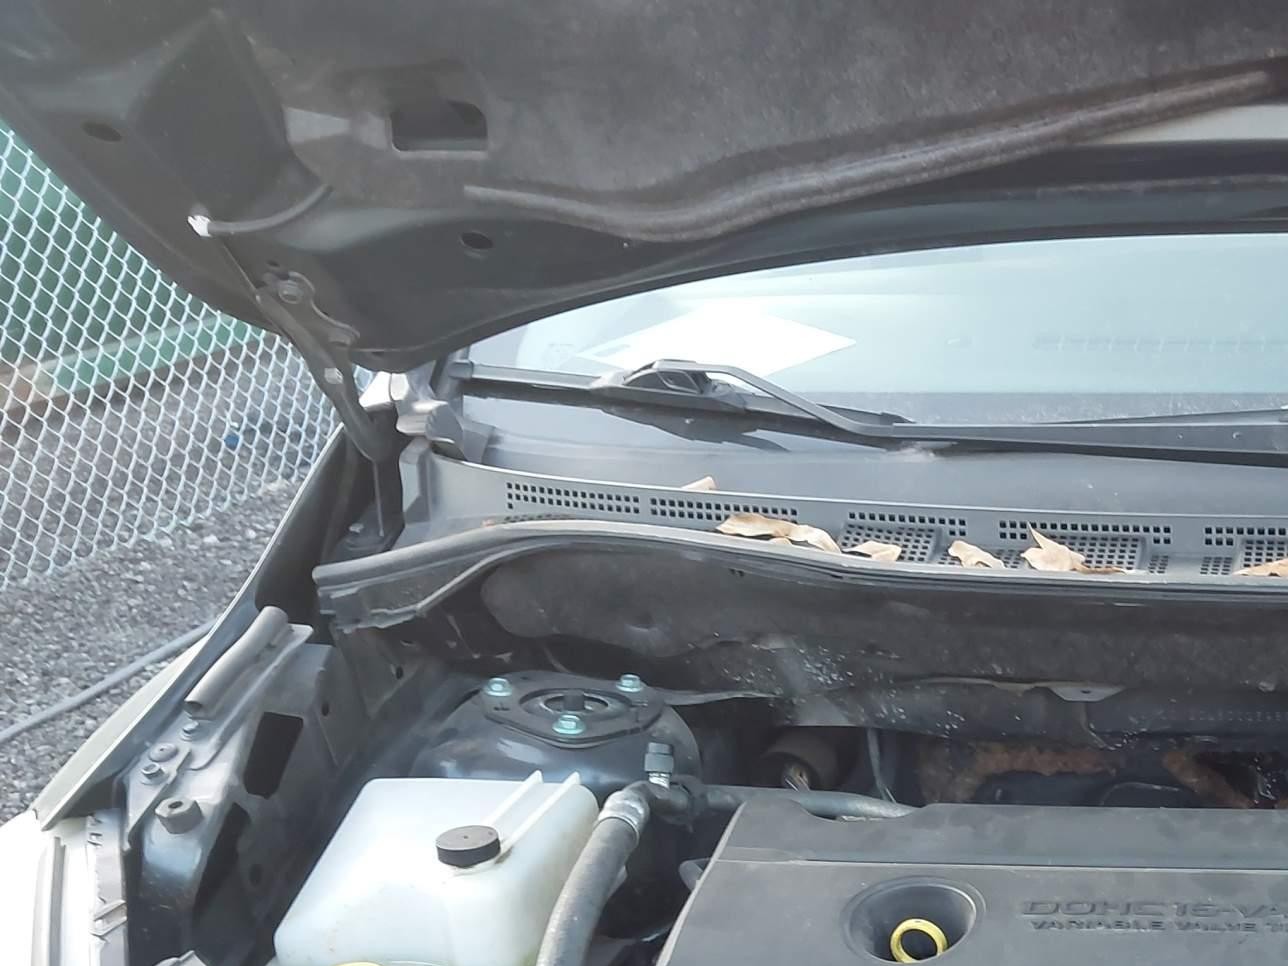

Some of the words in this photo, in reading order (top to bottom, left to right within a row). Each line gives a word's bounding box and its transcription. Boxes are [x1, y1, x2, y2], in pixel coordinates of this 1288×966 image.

[1023, 901, 1165, 916] DOHC
[1031, 919, 1166, 931] VARIABLE
[1174, 920, 1257, 932] VALVE
